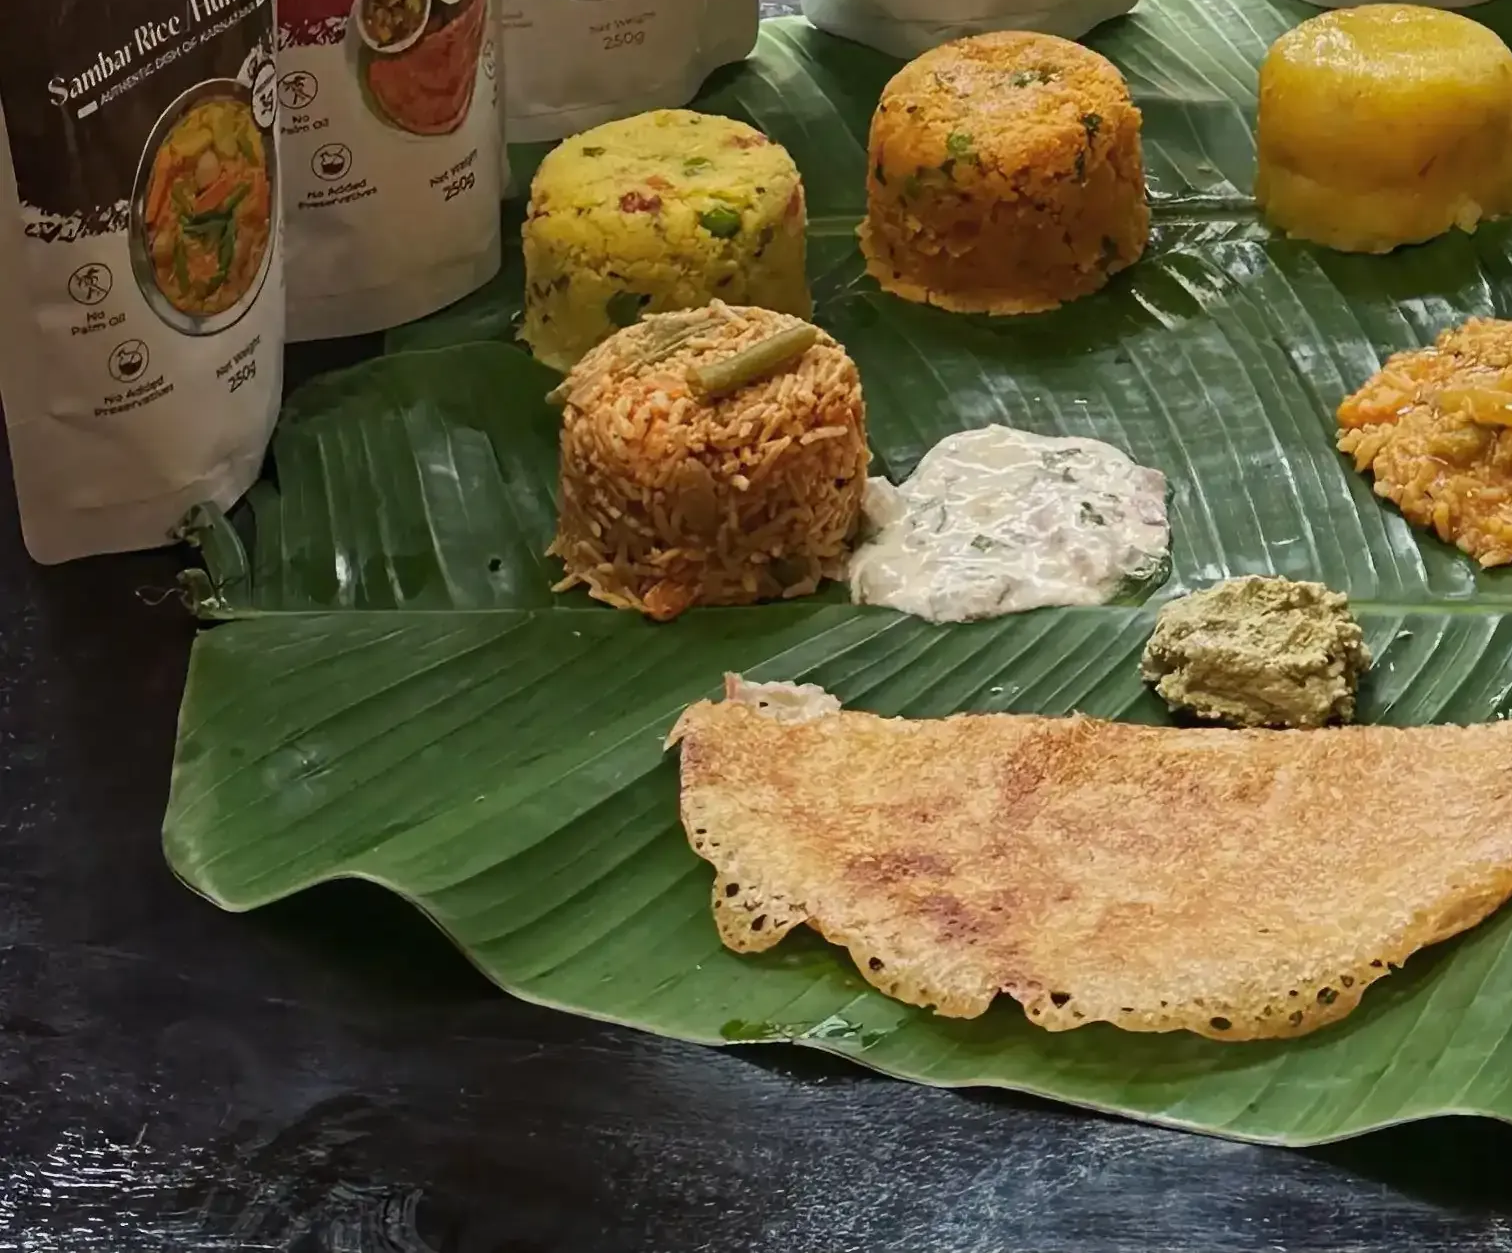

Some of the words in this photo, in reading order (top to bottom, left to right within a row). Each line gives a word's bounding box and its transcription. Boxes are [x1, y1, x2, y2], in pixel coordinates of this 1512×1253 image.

[603, 30, 646, 50] 250g
[47, 46, 133, 106] Sambar
[442, 172, 475, 202] 250g
[227, 360, 257, 394] 250g
